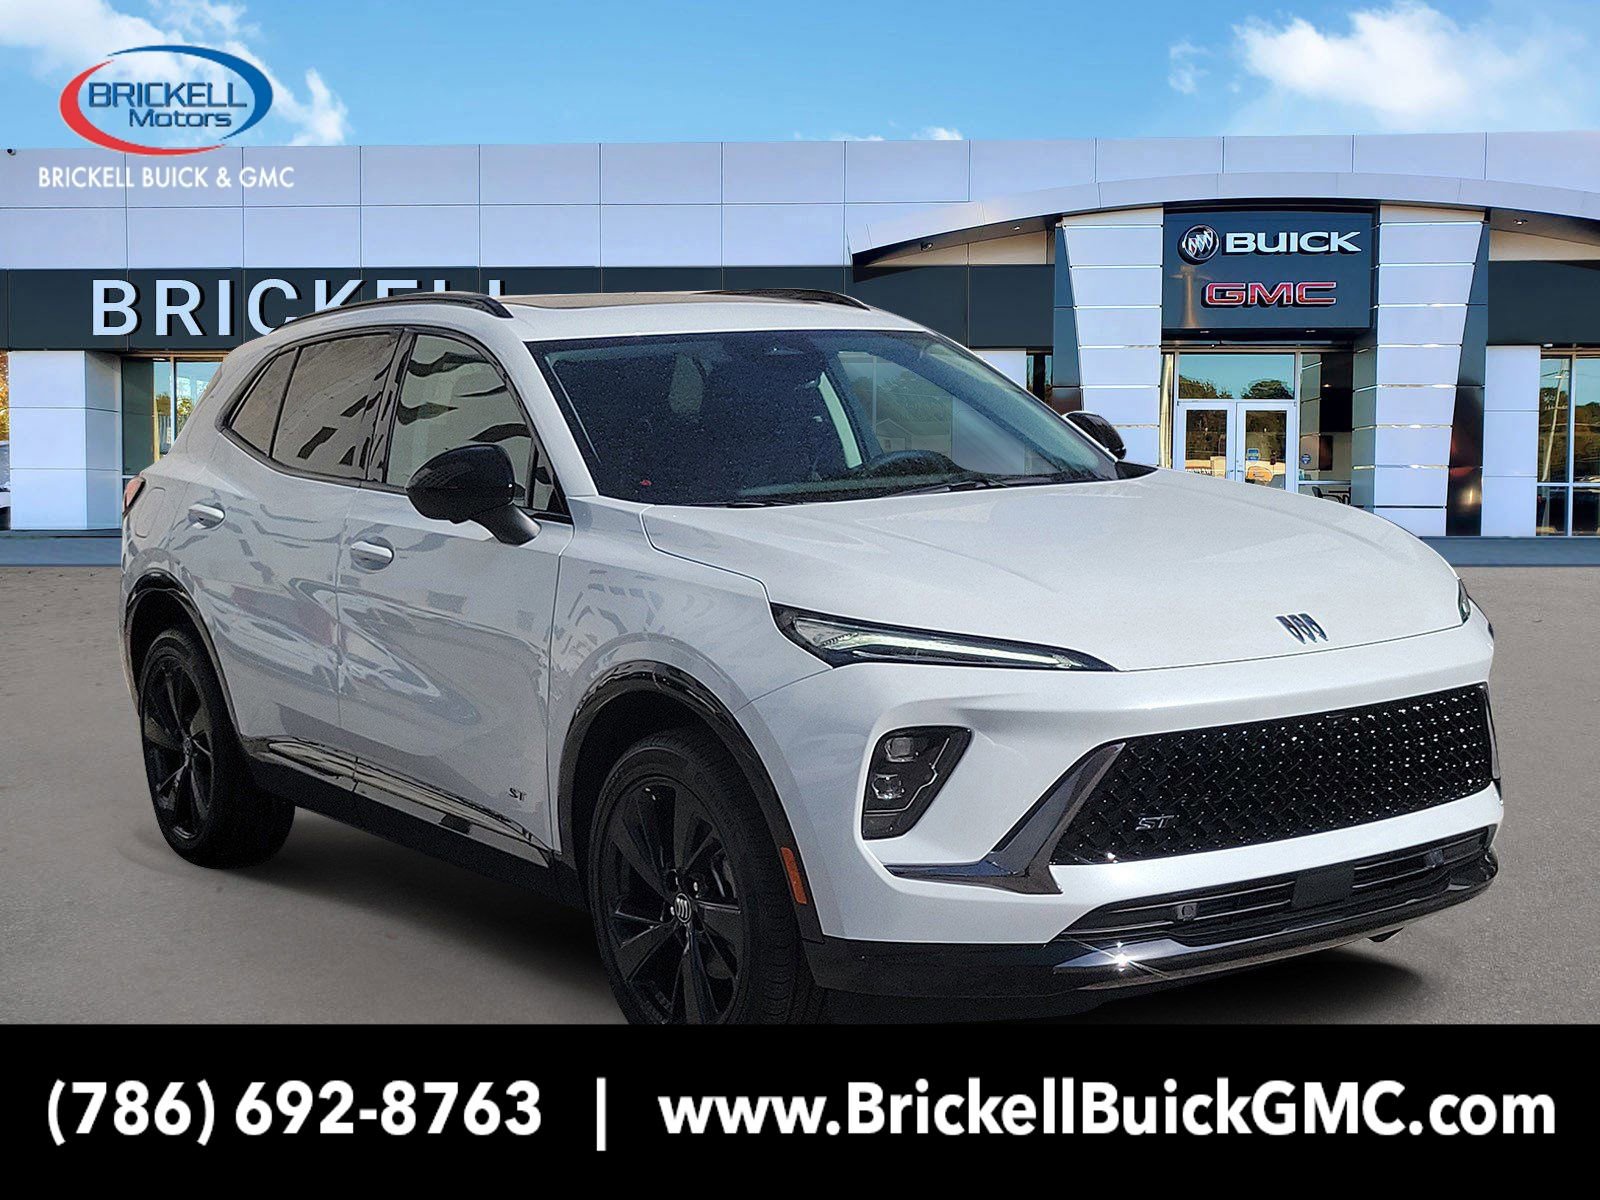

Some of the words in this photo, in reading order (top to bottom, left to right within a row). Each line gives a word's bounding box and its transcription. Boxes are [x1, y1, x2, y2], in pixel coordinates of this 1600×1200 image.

[1226, 231, 1362, 253] BUICK
[1206, 282, 1337, 305] GMC
[92, 279, 501, 336] BRICK
[508, 787, 527, 801] ST
[1135, 814, 1175, 831] ST
